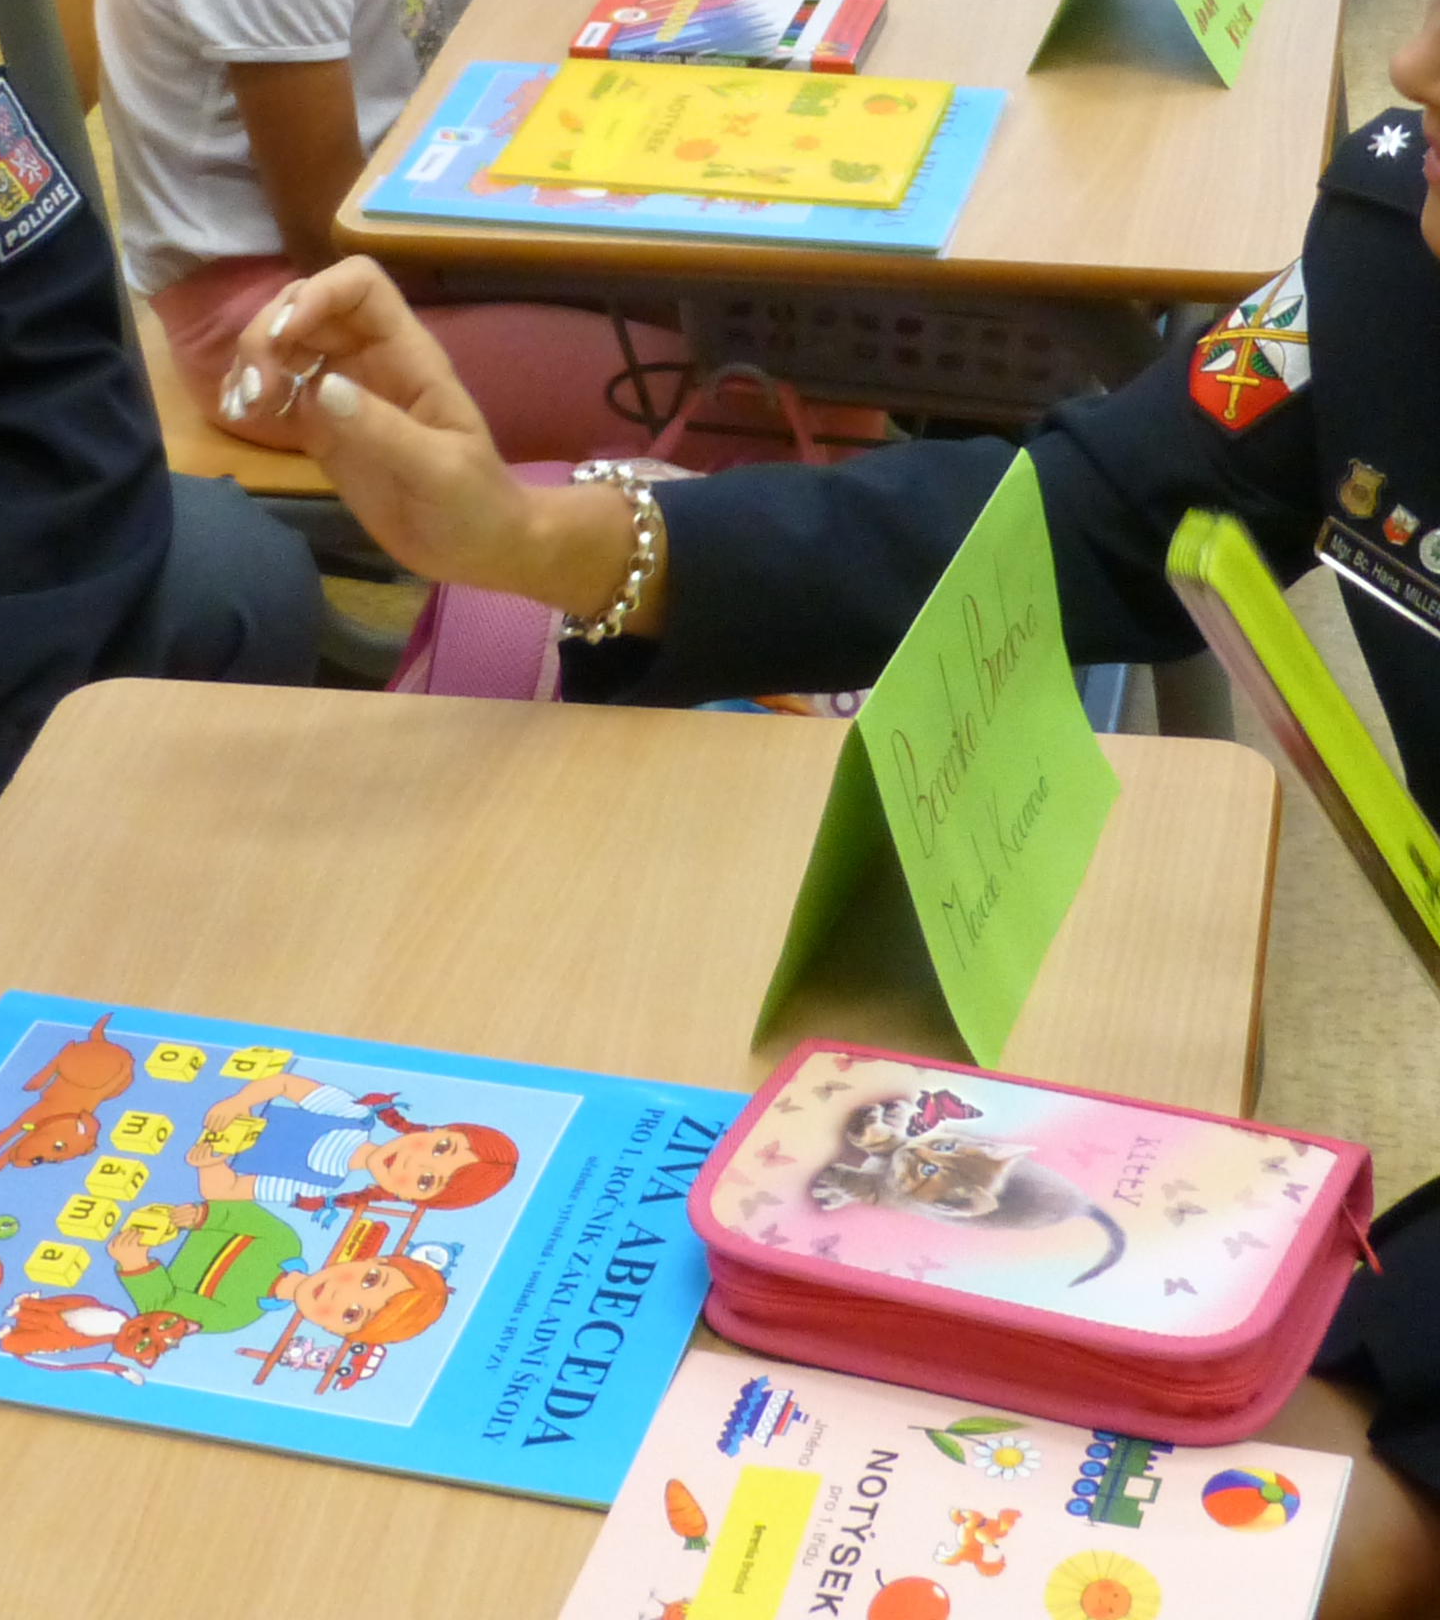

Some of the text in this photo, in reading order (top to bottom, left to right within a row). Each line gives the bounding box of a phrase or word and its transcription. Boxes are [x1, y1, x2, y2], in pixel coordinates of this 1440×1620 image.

[3, 183, 71, 248] POLICIE
[1371, 562, 1402, 597] Hana
[629, 1107, 666, 1145] PRO
[577, 1162, 635, 1250] ROČNÍK
[520, 1250, 593, 1370] ZÁKLADNÍ
[520, 1219, 668, 1450] ABECEDA
[481, 1368, 542, 1447] ŠKOLY
[798, 1417, 829, 1468] Jméno
[821, 1485, 843, 1512] pro
[801, 1531, 827, 1569] třídu
[808, 1448, 900, 1617] NOTÝSEK
